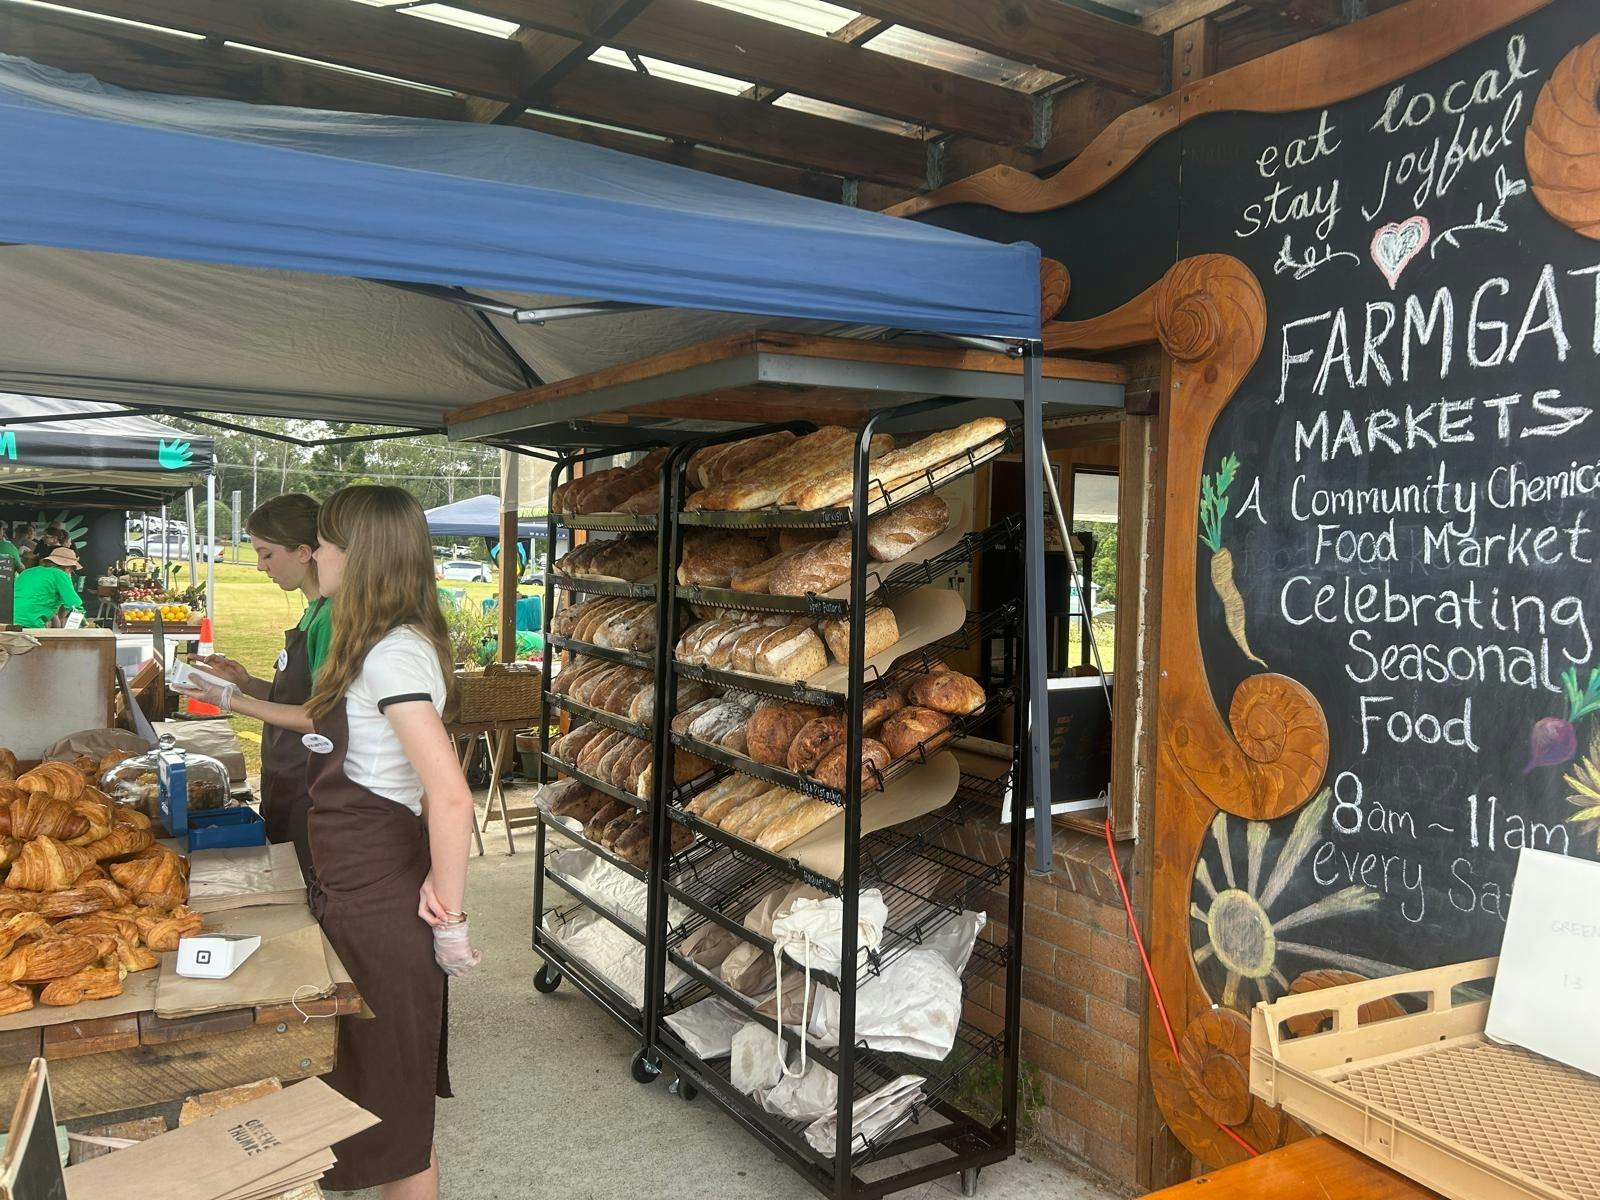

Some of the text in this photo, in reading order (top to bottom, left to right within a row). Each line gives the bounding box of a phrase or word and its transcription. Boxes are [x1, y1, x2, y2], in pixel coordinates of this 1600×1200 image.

[1256, 33, 1540, 178] eat local
[1234, 90, 1523, 240] stay joyful
[1295, 389, 1593, 463] MARKETS
[1235, 475, 1267, 524] A
[1291, 460, 1477, 536] Community
[1314, 517, 1400, 565] Food
[1423, 510, 1592, 567] Market
[1280, 575, 1593, 665] Celebrating
[1345, 629, 1563, 693] Seasonal
[1359, 696, 1479, 754] Food
[1332, 771, 1417, 839] 8am
[1467, 794, 1569, 856] 11am
[1312, 841, 1513, 922] every Sa
